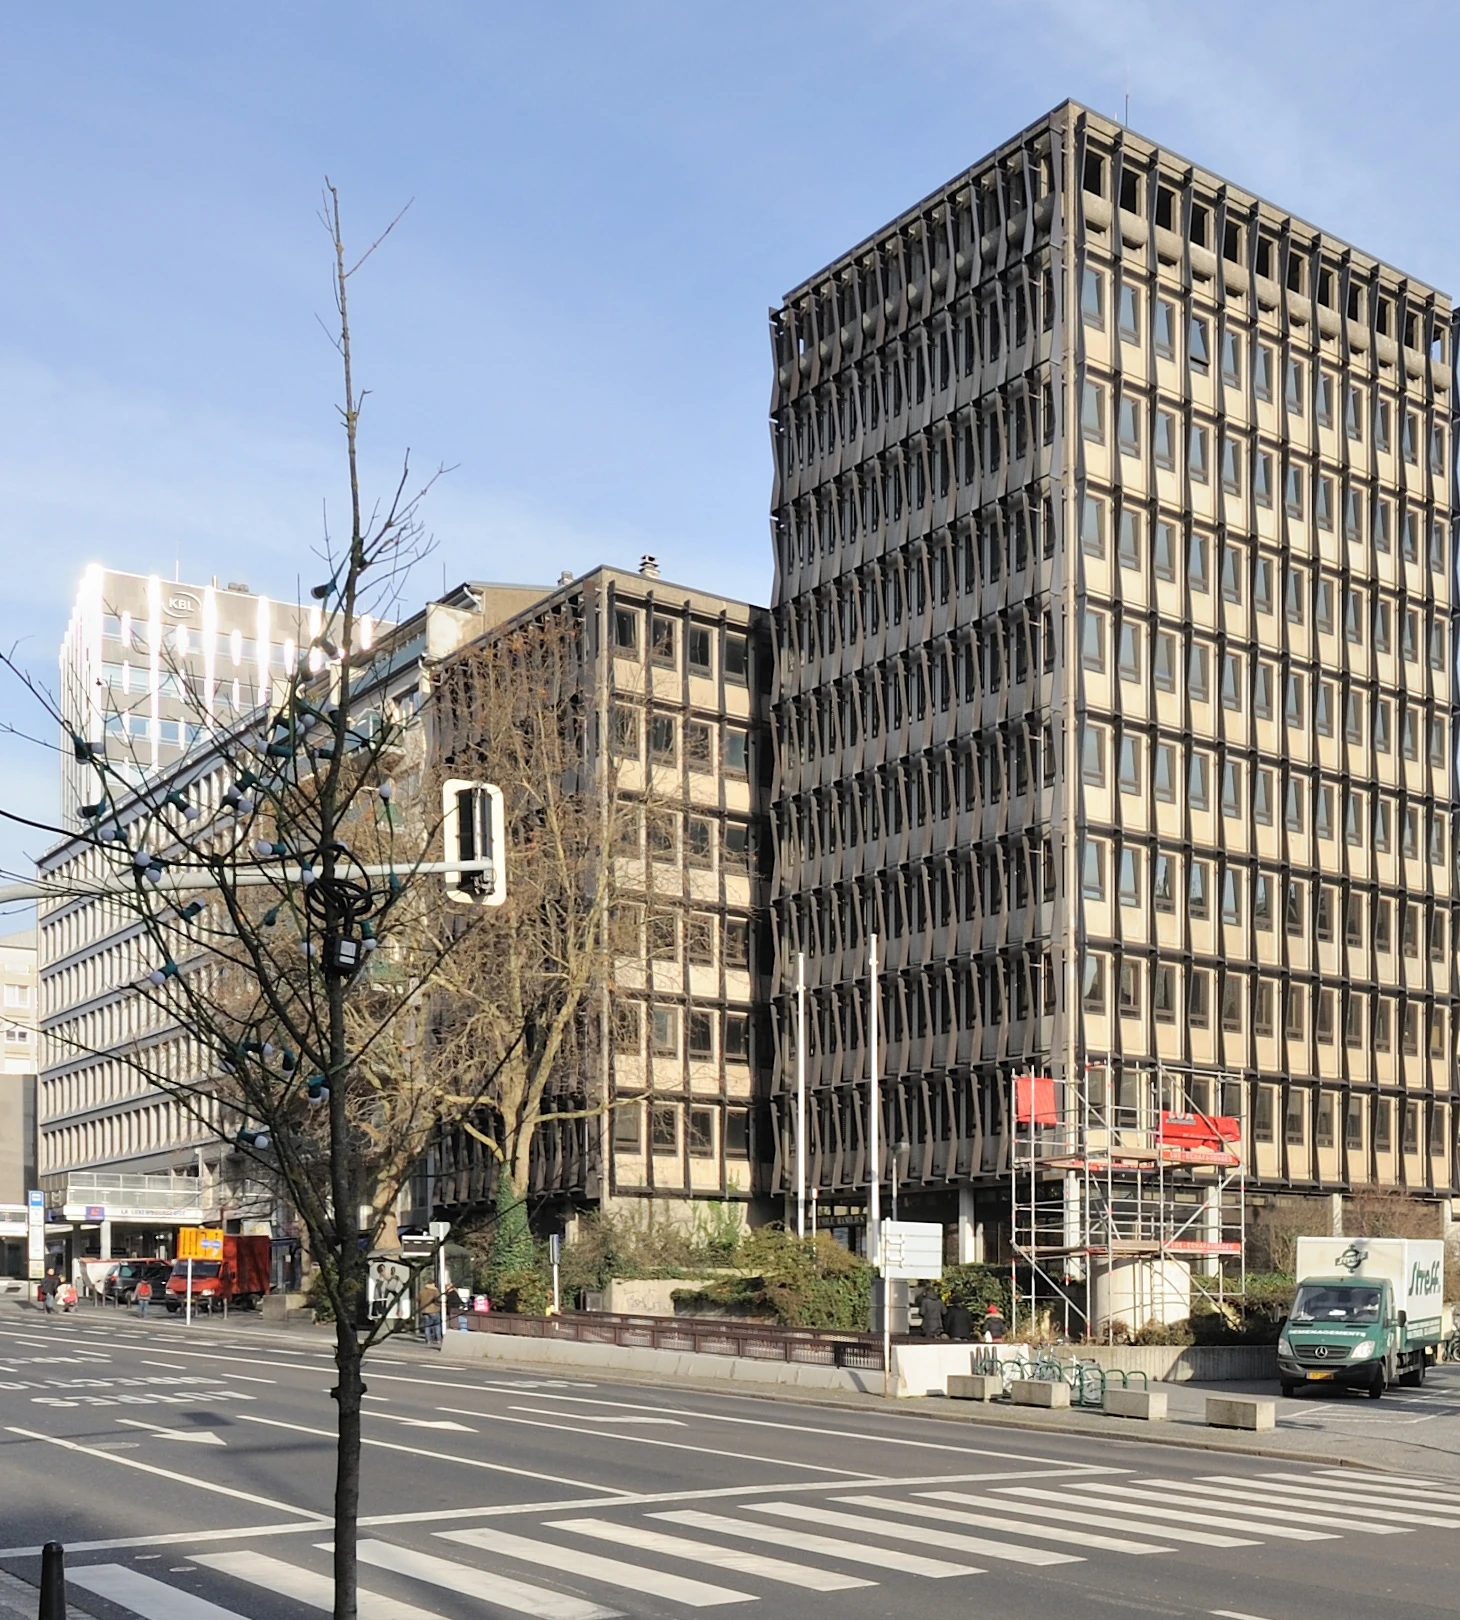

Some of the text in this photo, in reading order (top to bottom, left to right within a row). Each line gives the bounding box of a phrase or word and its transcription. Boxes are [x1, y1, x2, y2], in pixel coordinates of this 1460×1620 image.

[169, 597, 194, 611] KBL
[1408, 1260, 1440, 1296] Streff
[31, 1391, 257, 1407] AUTRES
